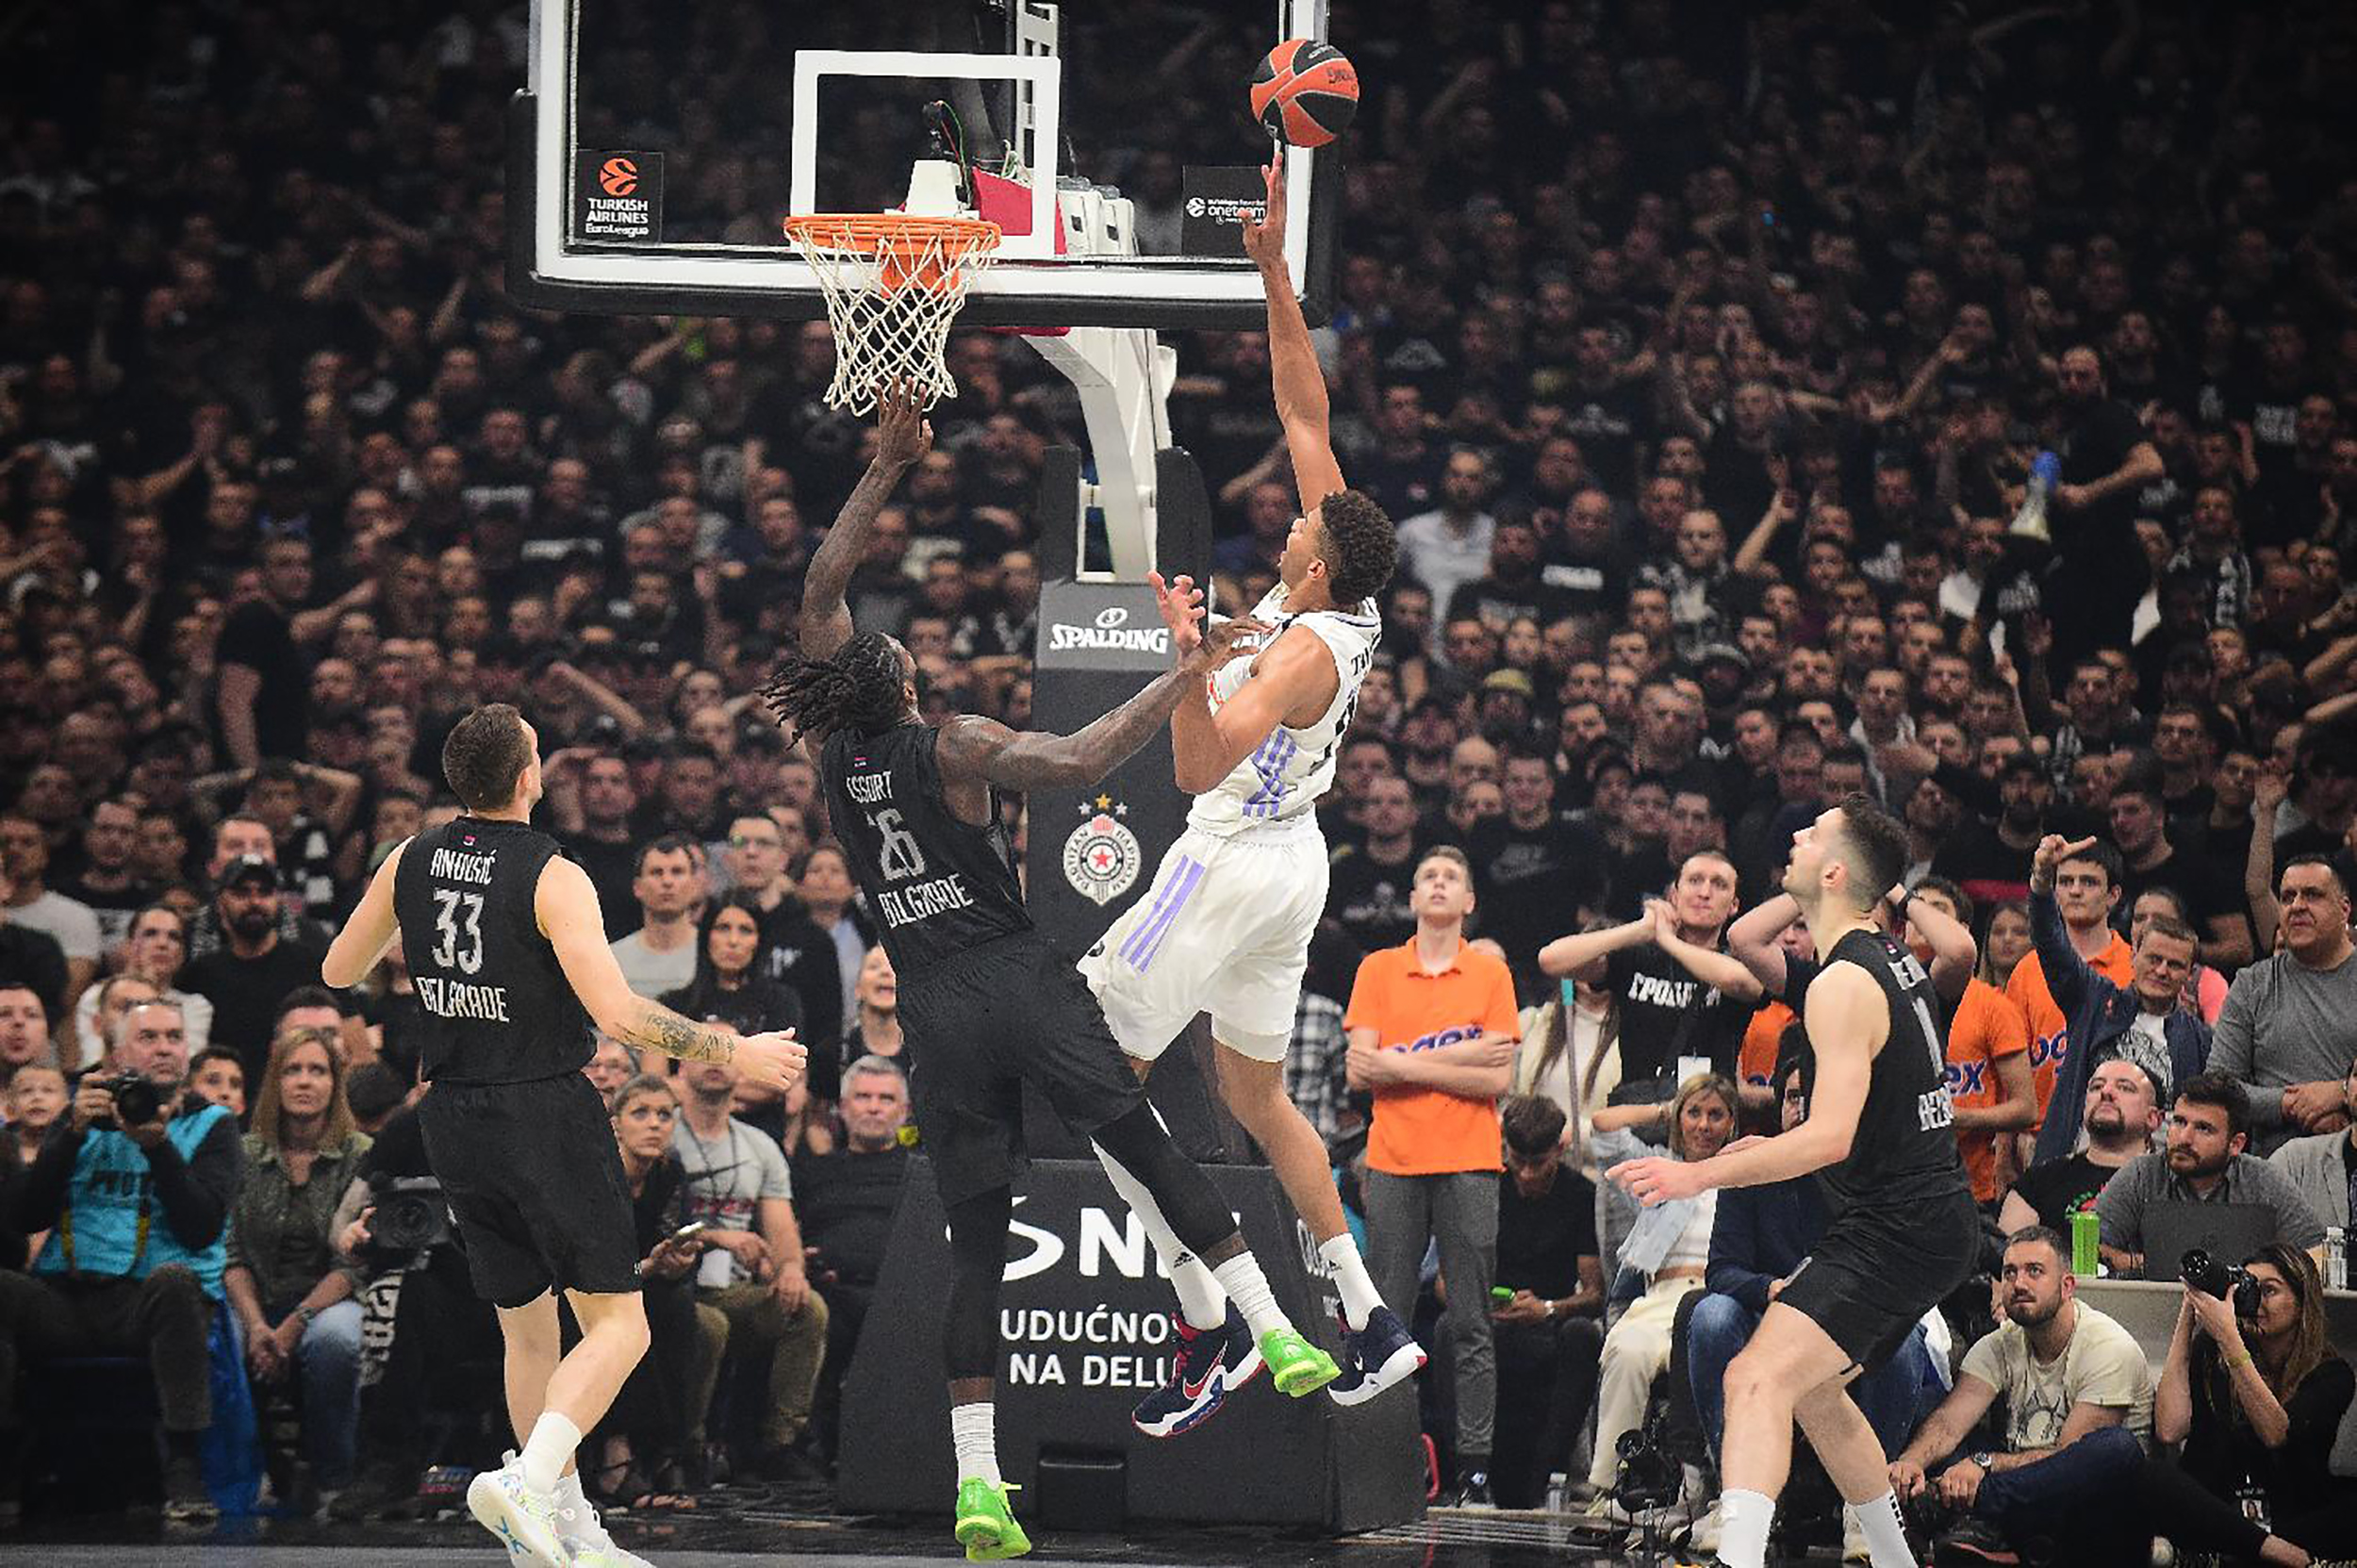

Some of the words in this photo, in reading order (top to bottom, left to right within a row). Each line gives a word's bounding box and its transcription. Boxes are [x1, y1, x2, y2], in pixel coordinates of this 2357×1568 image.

[585, 210, 649, 224] AIRLINES
[587, 198, 649, 211] TURKISH
[585, 223, 651, 238] EuroLeague
[1049, 623, 1169, 654] SPALDING
[432, 887, 486, 975] 33
[416, 976, 511, 1024] BELGRADE
[1000, 1304, 1169, 1345] UDUĆNO
[1009, 1353, 1066, 1386] NA
